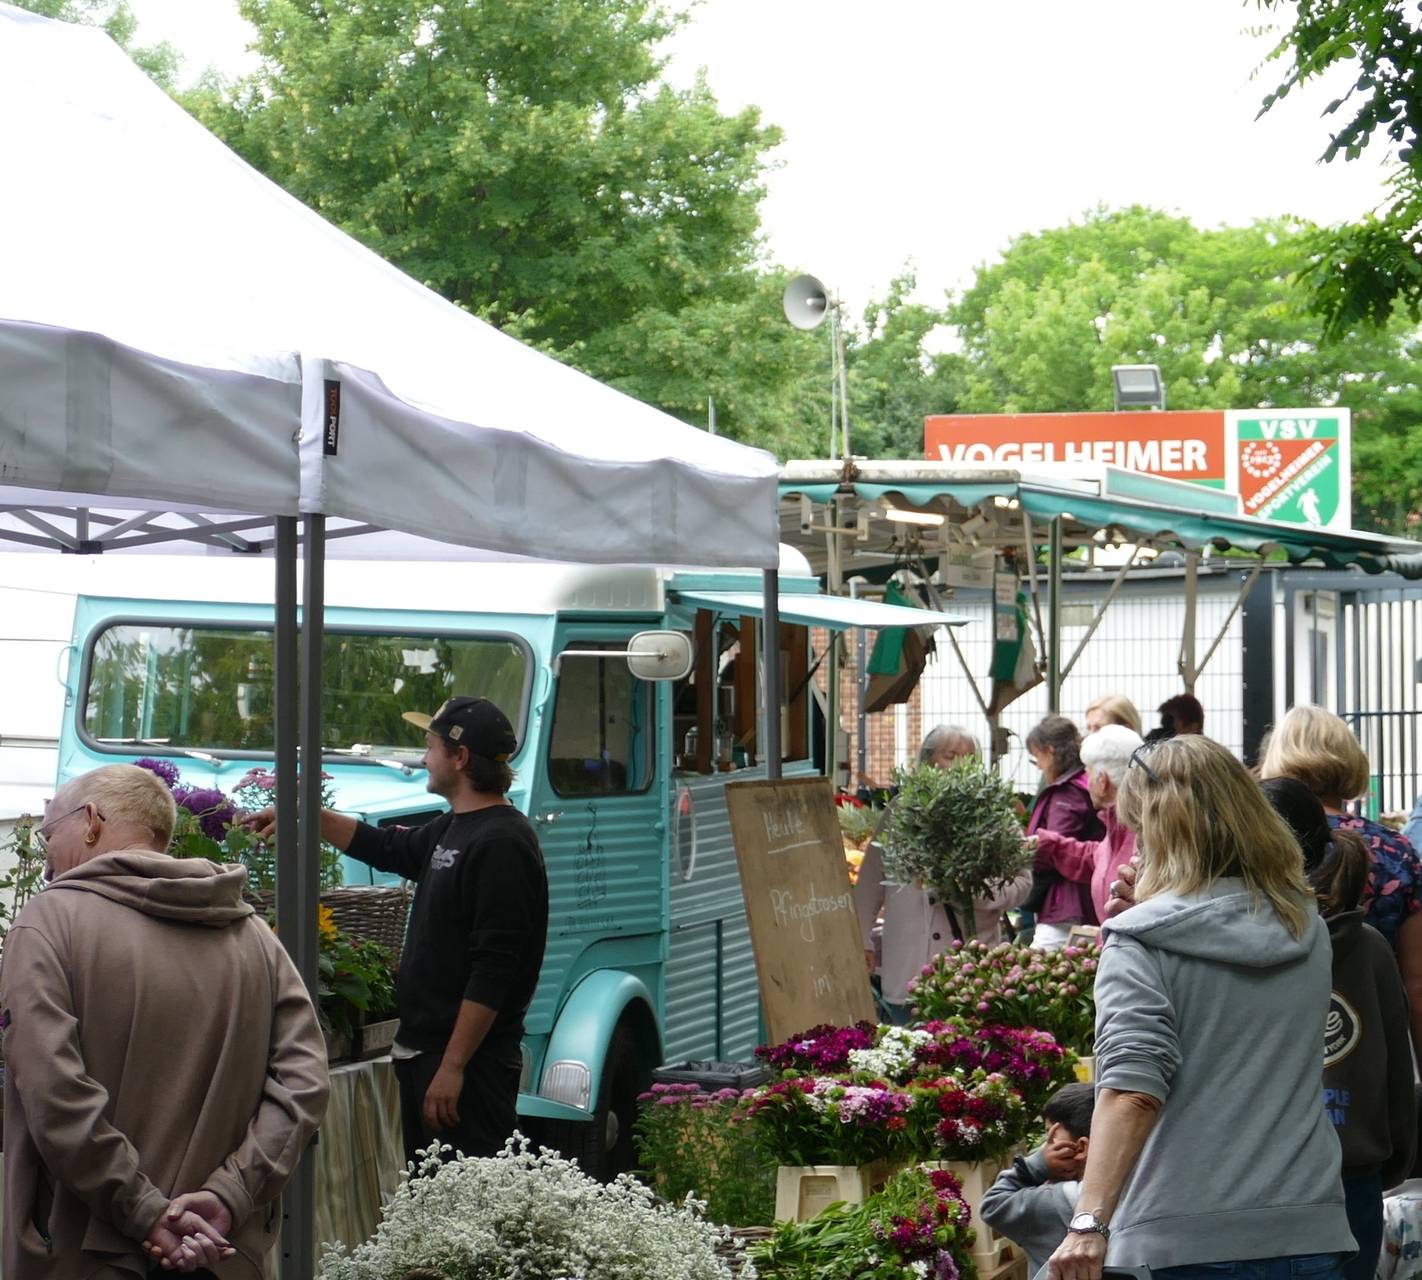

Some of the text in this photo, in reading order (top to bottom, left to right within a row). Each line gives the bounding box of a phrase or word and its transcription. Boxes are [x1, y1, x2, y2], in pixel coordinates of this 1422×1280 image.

[1258, 419, 1318, 439] VSV
[938, 440, 1207, 471] VOGELHEIMER
[1245, 441, 1325, 510] VOGELHEIMER
[1257, 453, 1333, 521] SPORTVEREIN
[762, 810, 806, 842] Heute
[769, 881, 855, 942] Pfingstrosen
